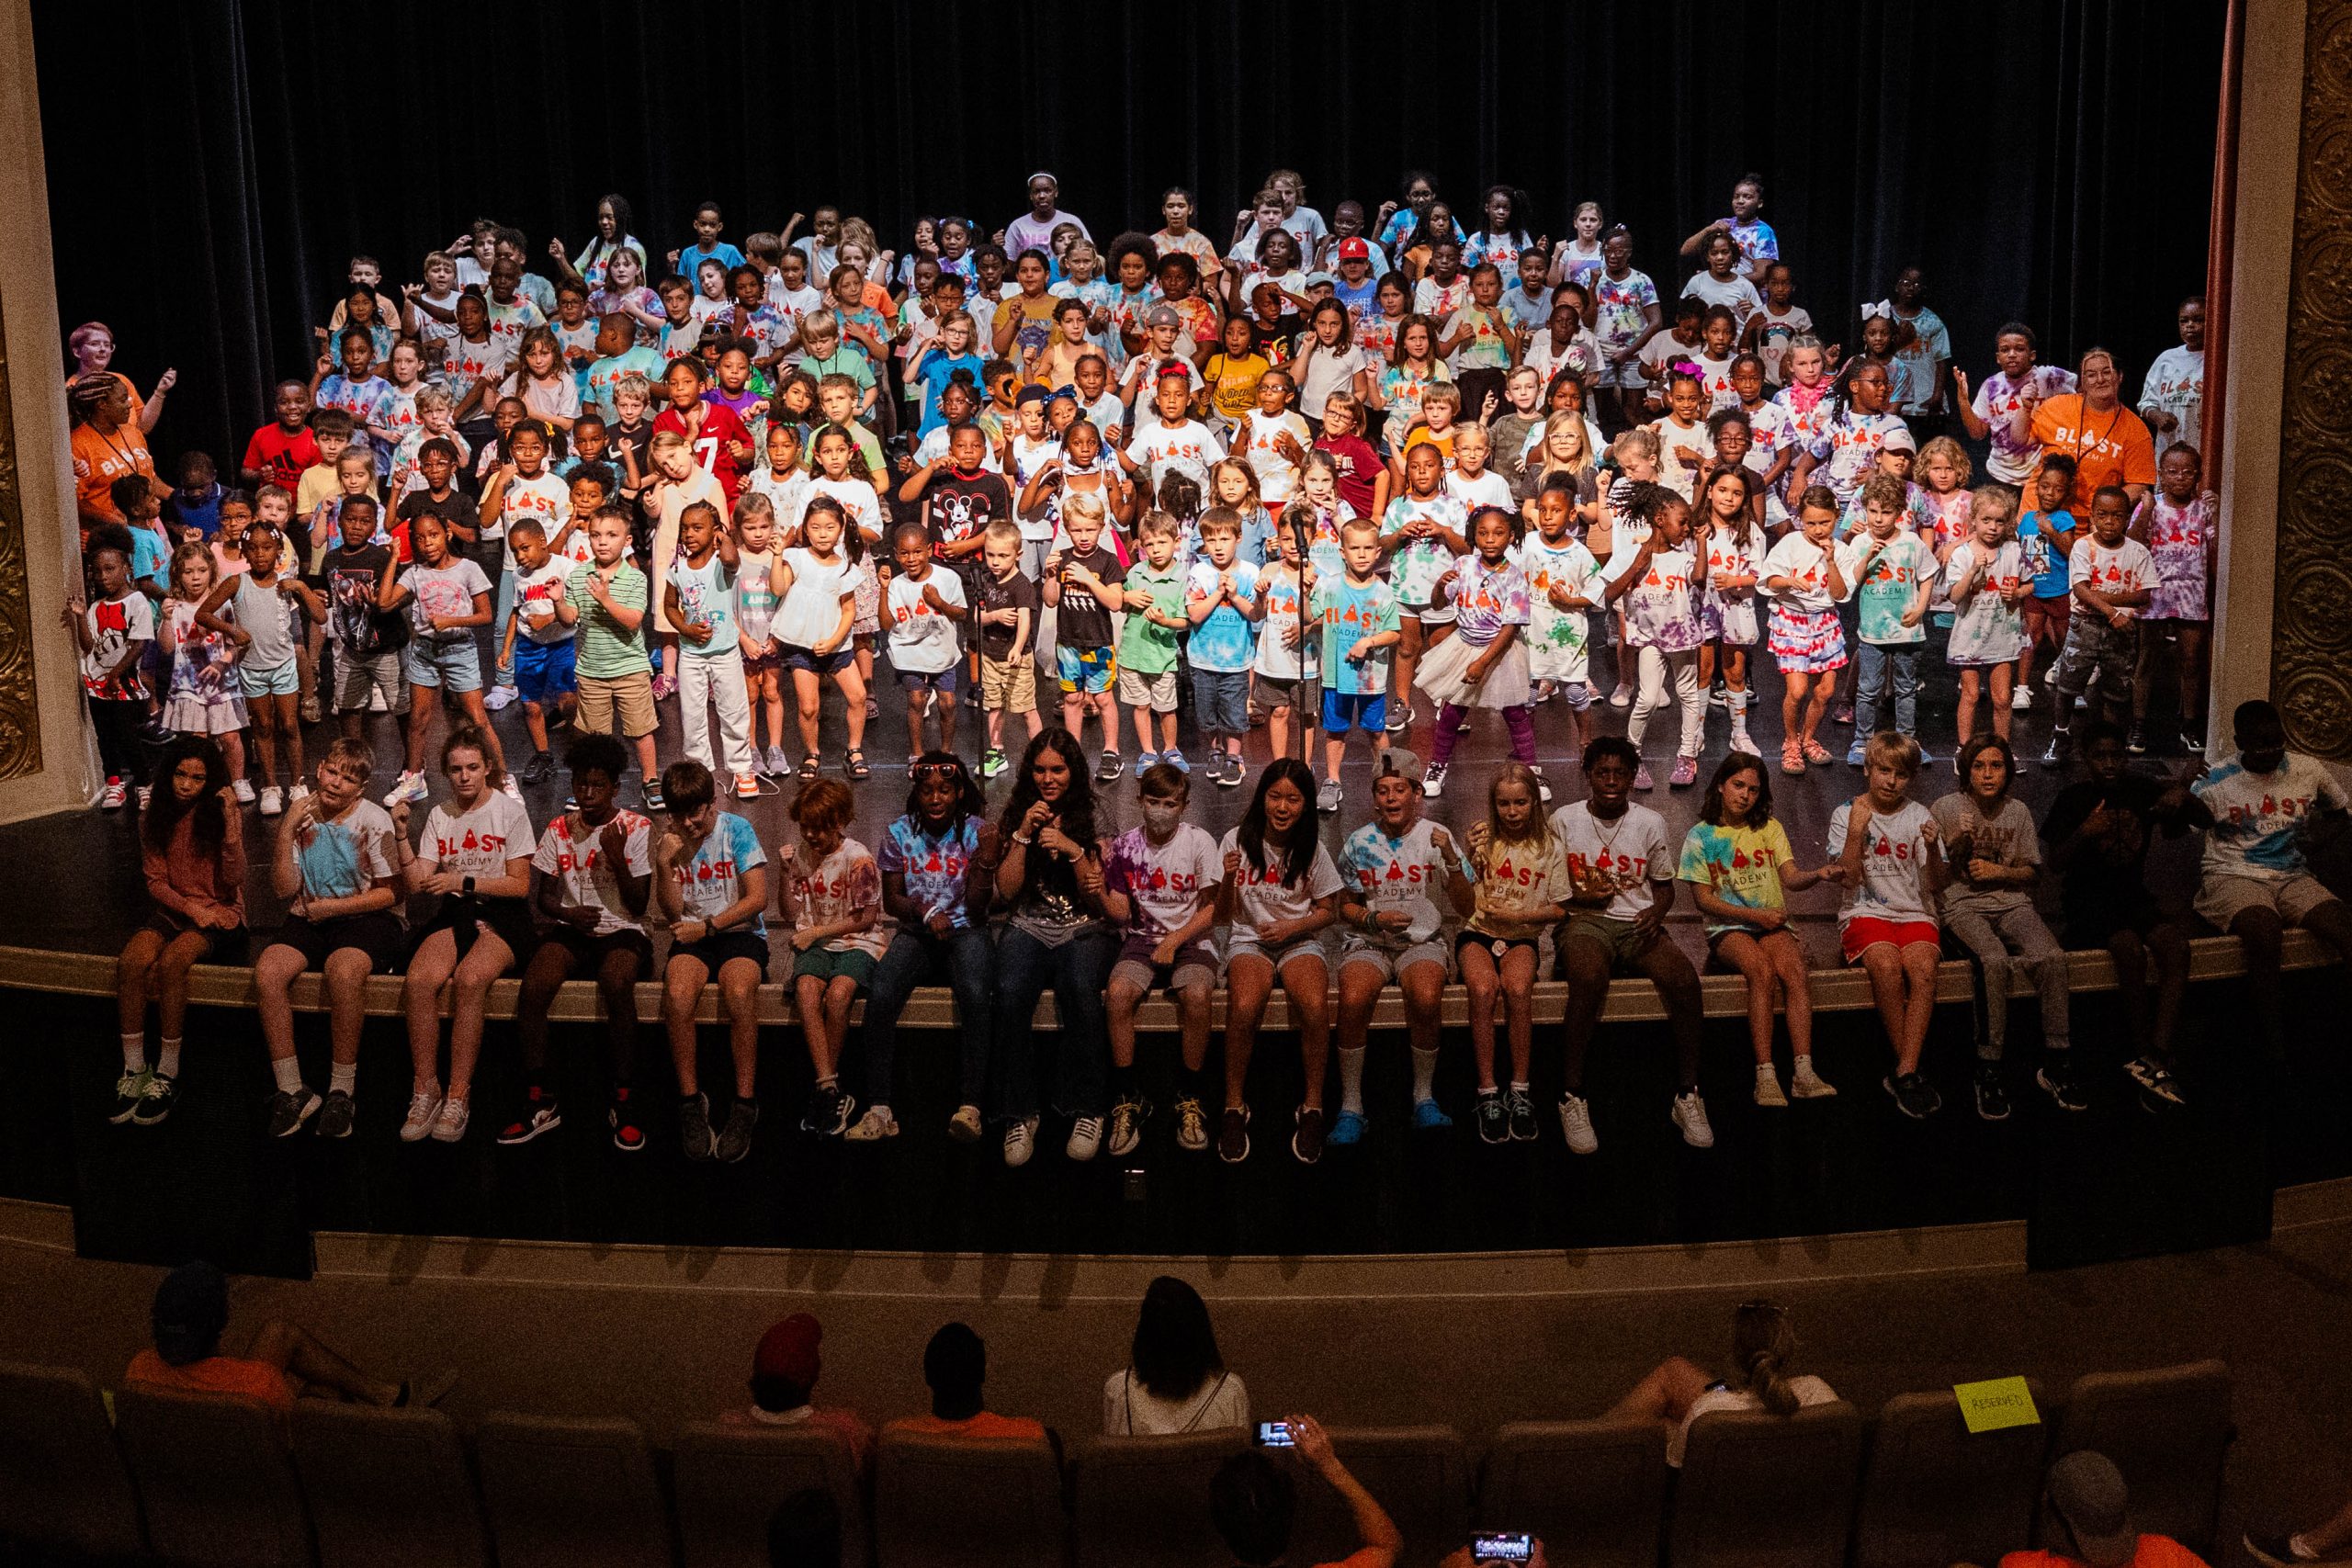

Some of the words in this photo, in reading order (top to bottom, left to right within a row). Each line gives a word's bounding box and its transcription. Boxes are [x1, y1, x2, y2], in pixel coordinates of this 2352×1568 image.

[2161, 377, 2202, 396] BLAS
[1833, 427, 1883, 449] BLAS
[2055, 427, 2122, 457] BLAST
[1312, 547, 1339, 555] ADEMY
[1211, 613, 1242, 622] CADEM
[176, 623, 216, 643] LAS
[1357, 860, 1435, 886] BLAST
[1484, 858, 1545, 890] LAST
[1377, 887, 1422, 897] CADEMY
[1972, 1395, 2023, 1409] RESERVED
